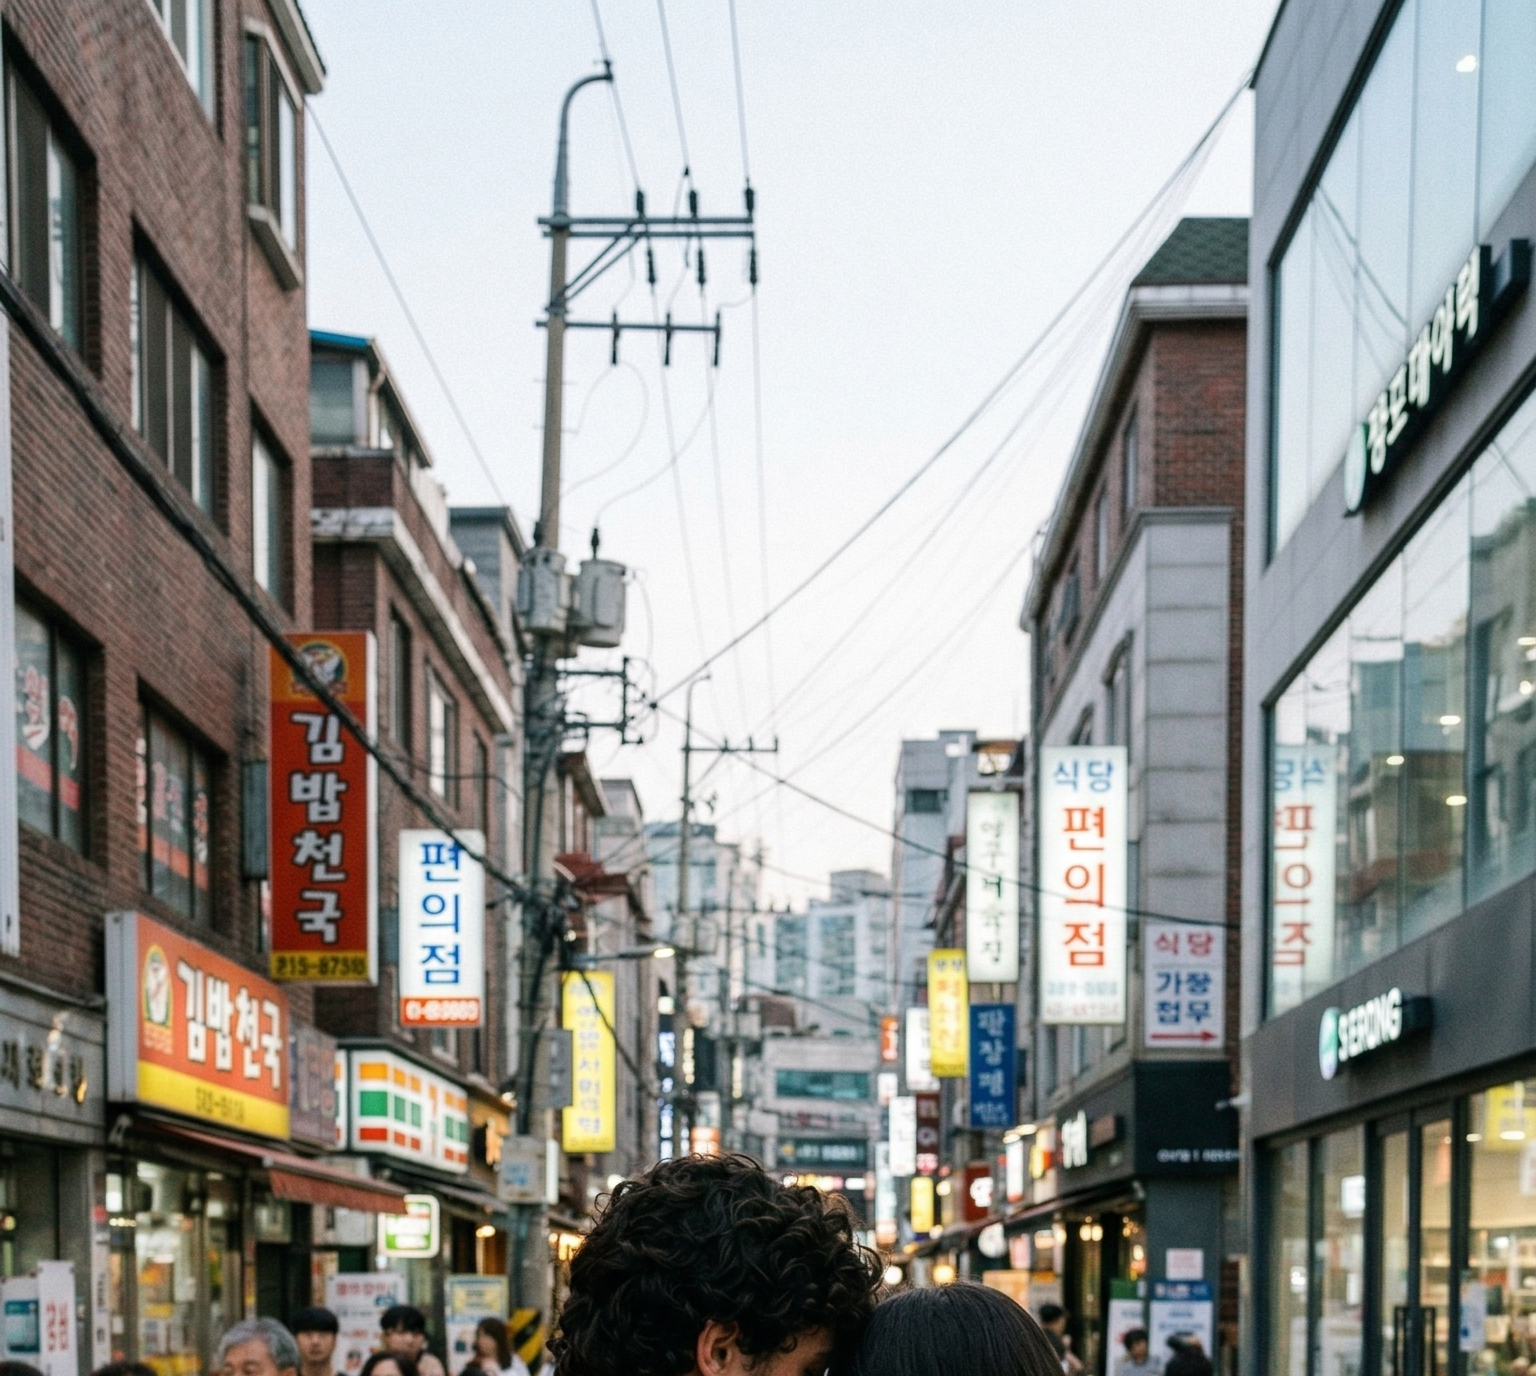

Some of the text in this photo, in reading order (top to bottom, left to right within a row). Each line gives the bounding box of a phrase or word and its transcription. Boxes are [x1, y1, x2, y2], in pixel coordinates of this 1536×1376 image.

[291, 711, 348, 944] 김밥천국
[1055, 761, 1113, 793] 식당
[420, 842, 460, 984] 편의점
[1063, 806, 1105, 967] 편의점
[1155, 932, 1214, 957] 식당
[177, 957, 283, 1091] 김밥천국
